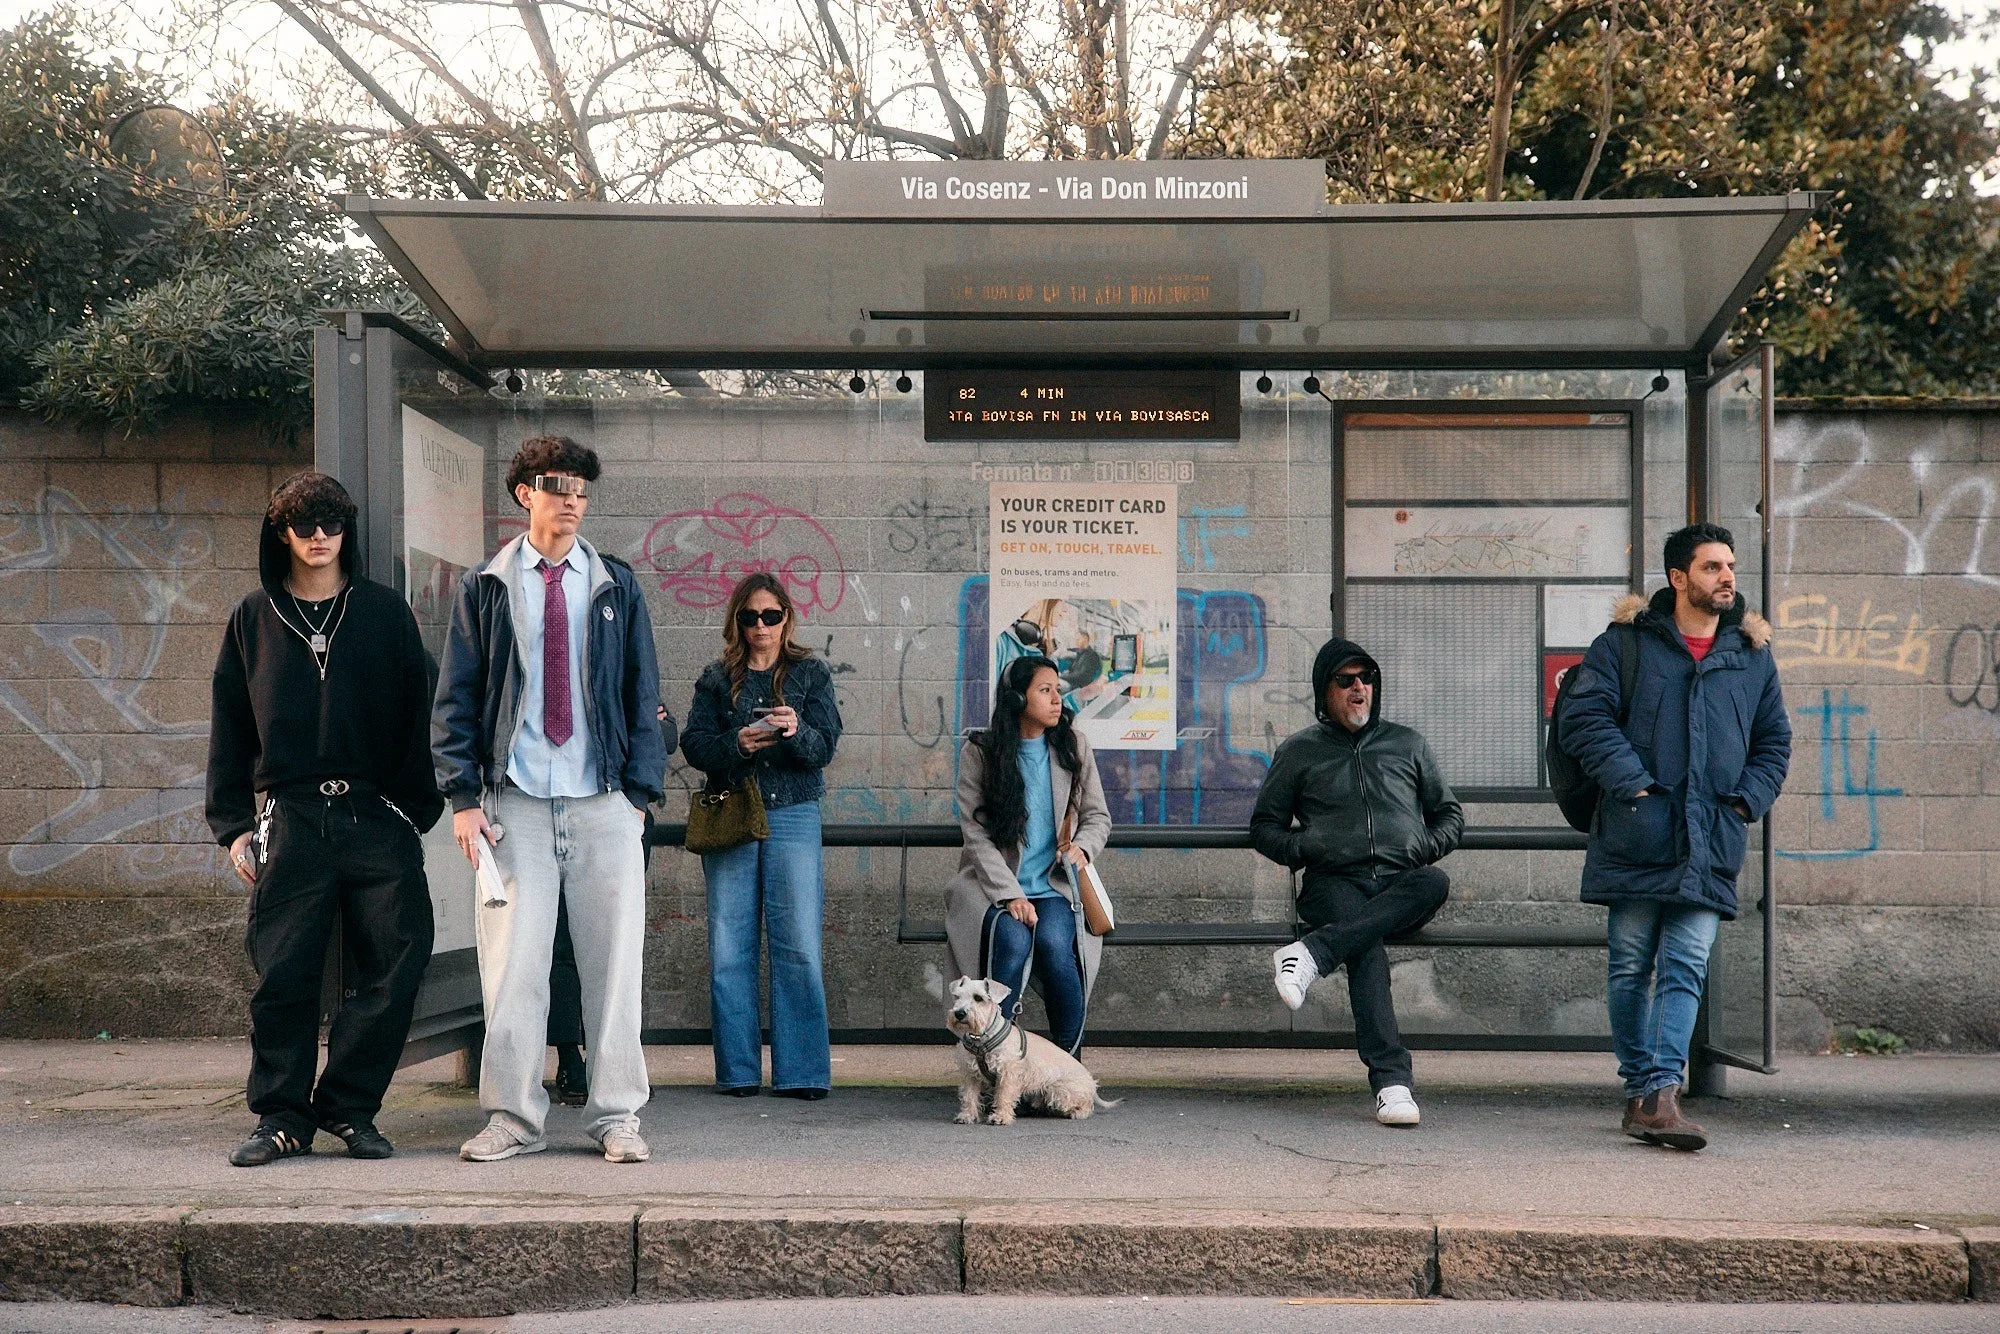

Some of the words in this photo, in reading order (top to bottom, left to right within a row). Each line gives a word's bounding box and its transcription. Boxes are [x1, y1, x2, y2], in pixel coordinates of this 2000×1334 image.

[900, 176, 938, 200] Via
[945, 176, 1031, 200] Cosenz
[1056, 176, 1093, 200] Via
[1101, 177, 1147, 199] Don
[1155, 176, 1249, 199] Minzoni
[959, 388, 976, 400] 82
[1020, 388, 1028, 399] 4
[1037, 388, 1064, 400] MIN
[981, 410, 1034, 422] BOVISA
[1043, 410, 1060, 422] FN
[1070, 410, 1087, 422] IN
[1095, 410, 1122, 422] VIA
[1130, 410, 1210, 422] BOVISASCA
[970, 461, 1051, 482] Fermata
[1060, 462, 1081, 481] n°
[1001, 498, 1047, 512] YOUR
[1052, 499, 1115, 513] CREDIT
[1119, 500, 1166, 514] CARD
[1001, 519, 1016, 533] IS
[1022, 519, 1068, 534] YOUR
[1073, 520, 1139, 535] TICKET.
[1001, 542, 1026, 553] GET
[1030, 543, 1051, 555] ON,
[1055, 543, 1103, 555] TOUCH,
[1107, 543, 1162, 555] TRAVEL.
[1000, 568, 1012, 576] On
[1014, 568, 1042, 577] buses,
[1044, 569, 1070, 577] trams
[1072, 569, 1088, 577] and
[1090, 569, 1119, 577] metro.
[1024, 579, 1040, 588] fast
[1042, 579, 1058, 588] and
[1060, 580, 1071, 588] no
[344, 988, 357, 998] 04
